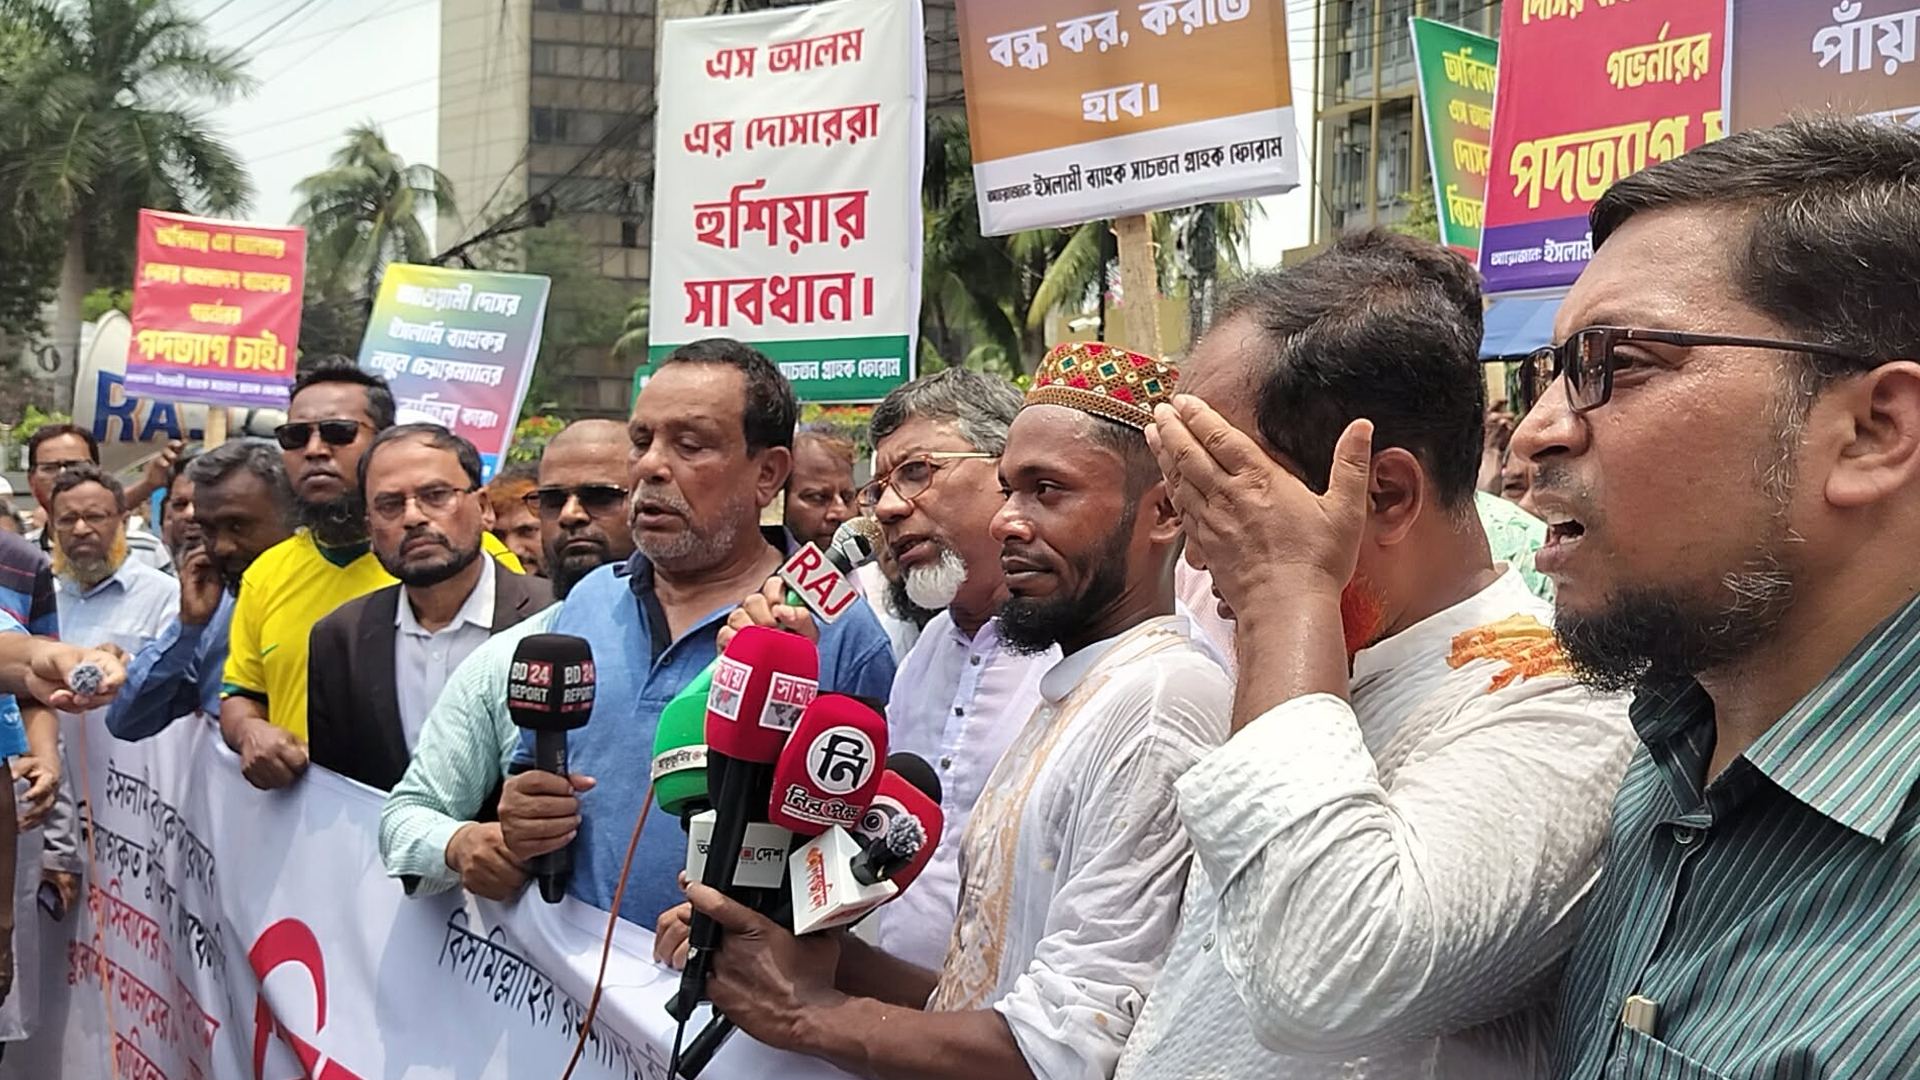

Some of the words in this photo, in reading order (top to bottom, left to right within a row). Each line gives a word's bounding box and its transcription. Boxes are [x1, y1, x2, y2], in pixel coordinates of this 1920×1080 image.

[705, 47, 757, 81] এস
[768, 28, 864, 74] আলম
[986, 25, 1049, 70] বন্ধ
[684, 120, 735, 159] এর
[1033, 164, 1082, 197] ইসলামী
[1085, 163, 1126, 189] ব্যাংক
[1183, 145, 1225, 174] গ্রাহক
[1229, 136, 1283, 167] ফোরাম
[693, 180, 870, 255] হুশিয়ার
[684, 272, 874, 328] সাবধান।
[137, 329, 231, 368] পদত্যাগ
[786, 546, 856, 616] RAJ
[509, 684, 549, 703] REPORT
[529, 663, 551, 685] 24
[817, 734, 868, 789] নি
